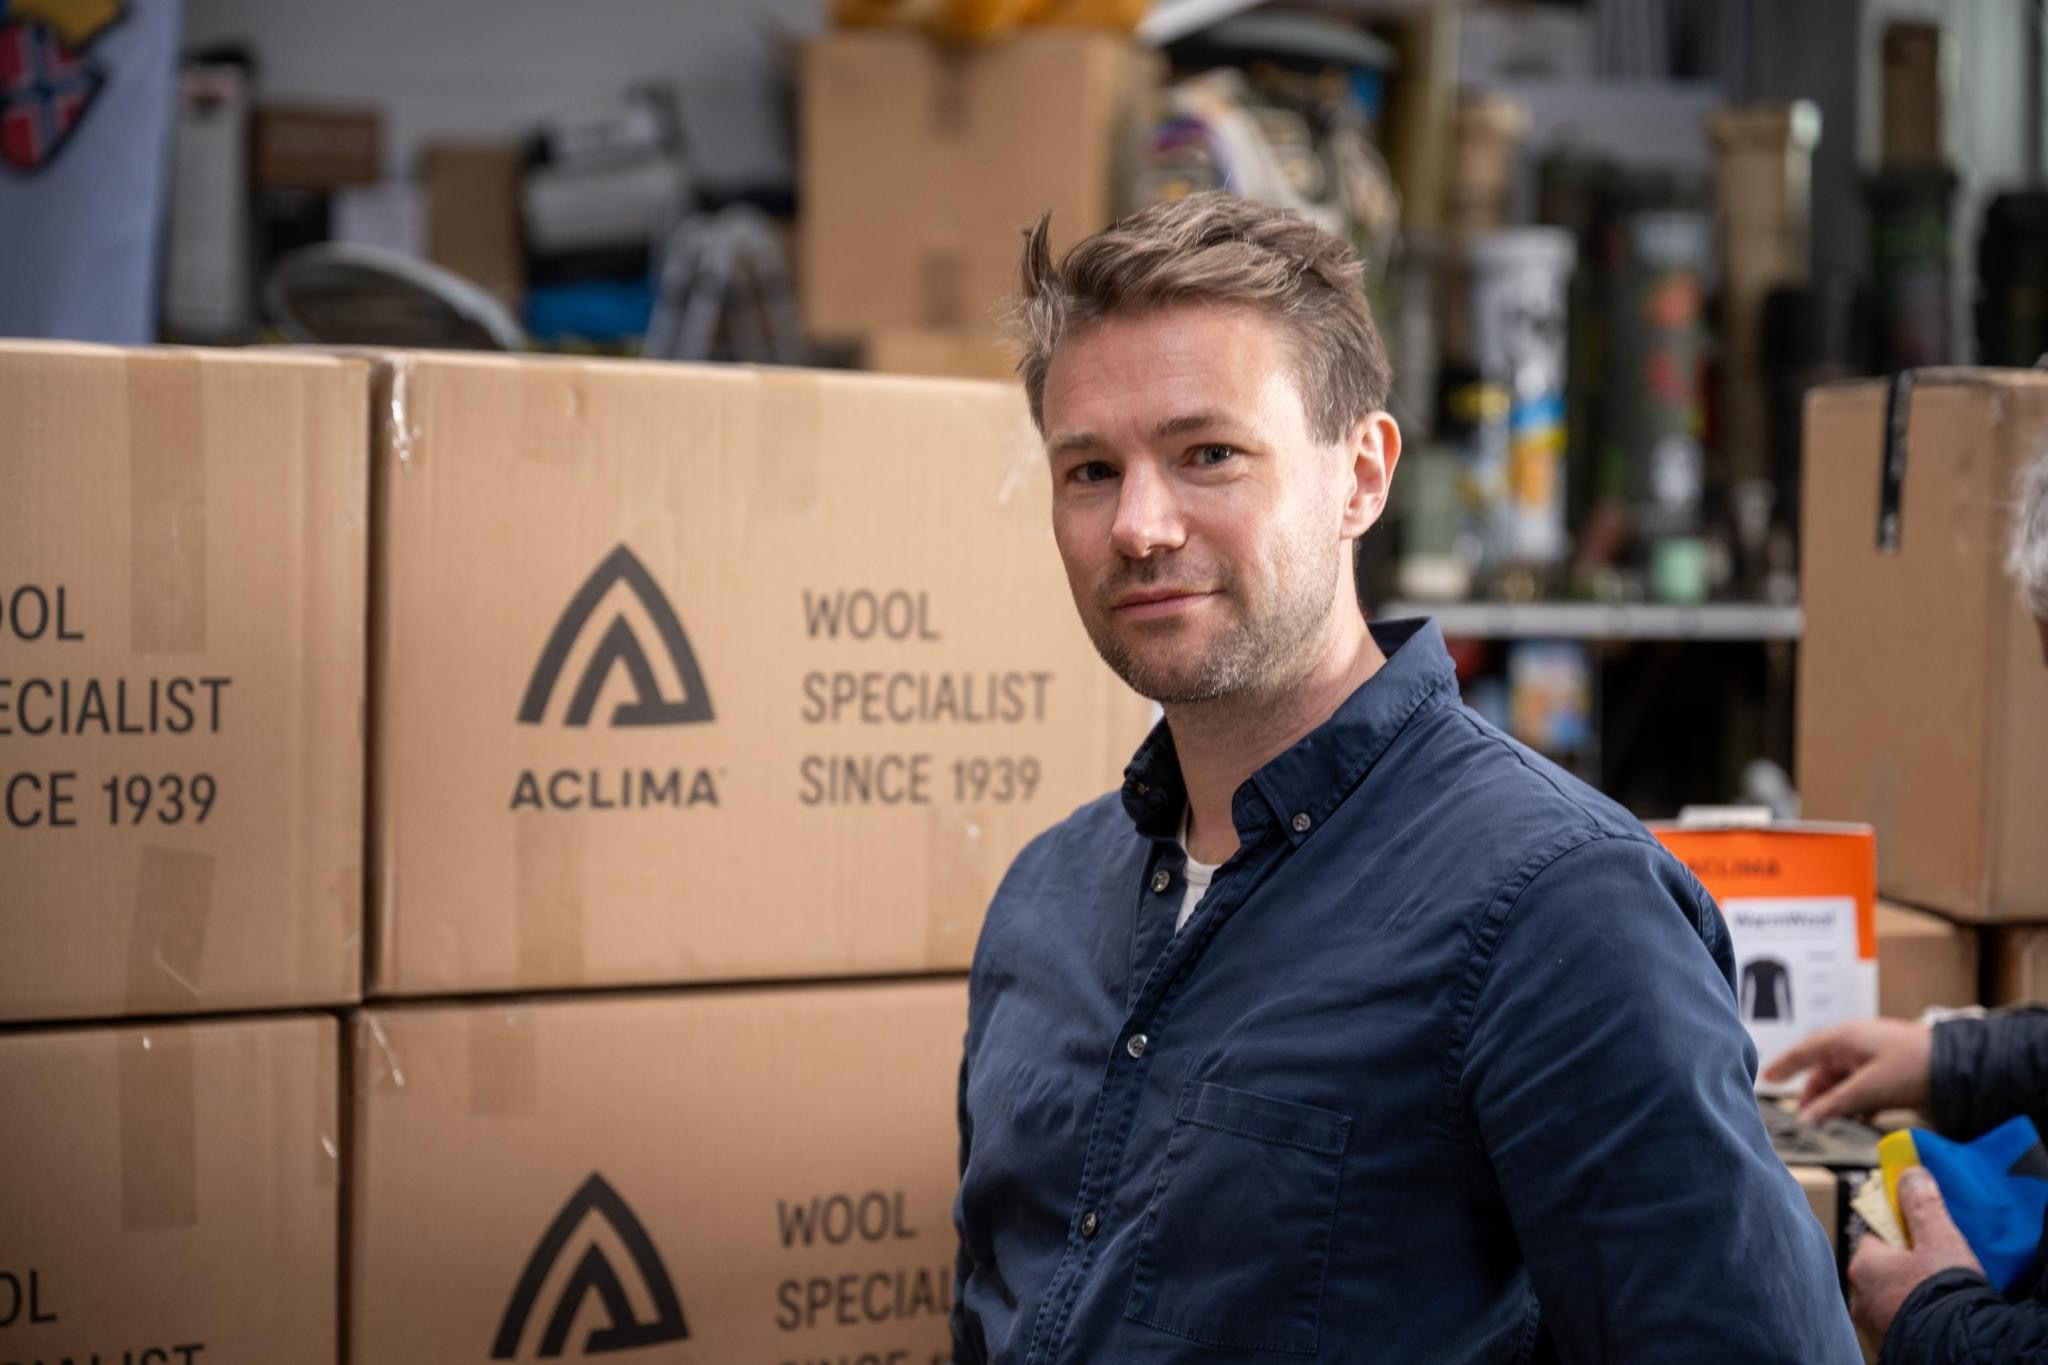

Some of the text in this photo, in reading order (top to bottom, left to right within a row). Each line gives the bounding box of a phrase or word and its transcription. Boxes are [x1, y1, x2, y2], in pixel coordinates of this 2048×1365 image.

[0, 583, 85, 642] OL
[801, 588, 942, 642] WOOL
[800, 671, 1054, 726] SPECIALIST
[101, 773, 217, 827] 1939
[507, 767, 720, 813] ACLIMA
[798, 754, 1042, 807] SINCE 1939
[776, 1191, 917, 1248] WOOL
